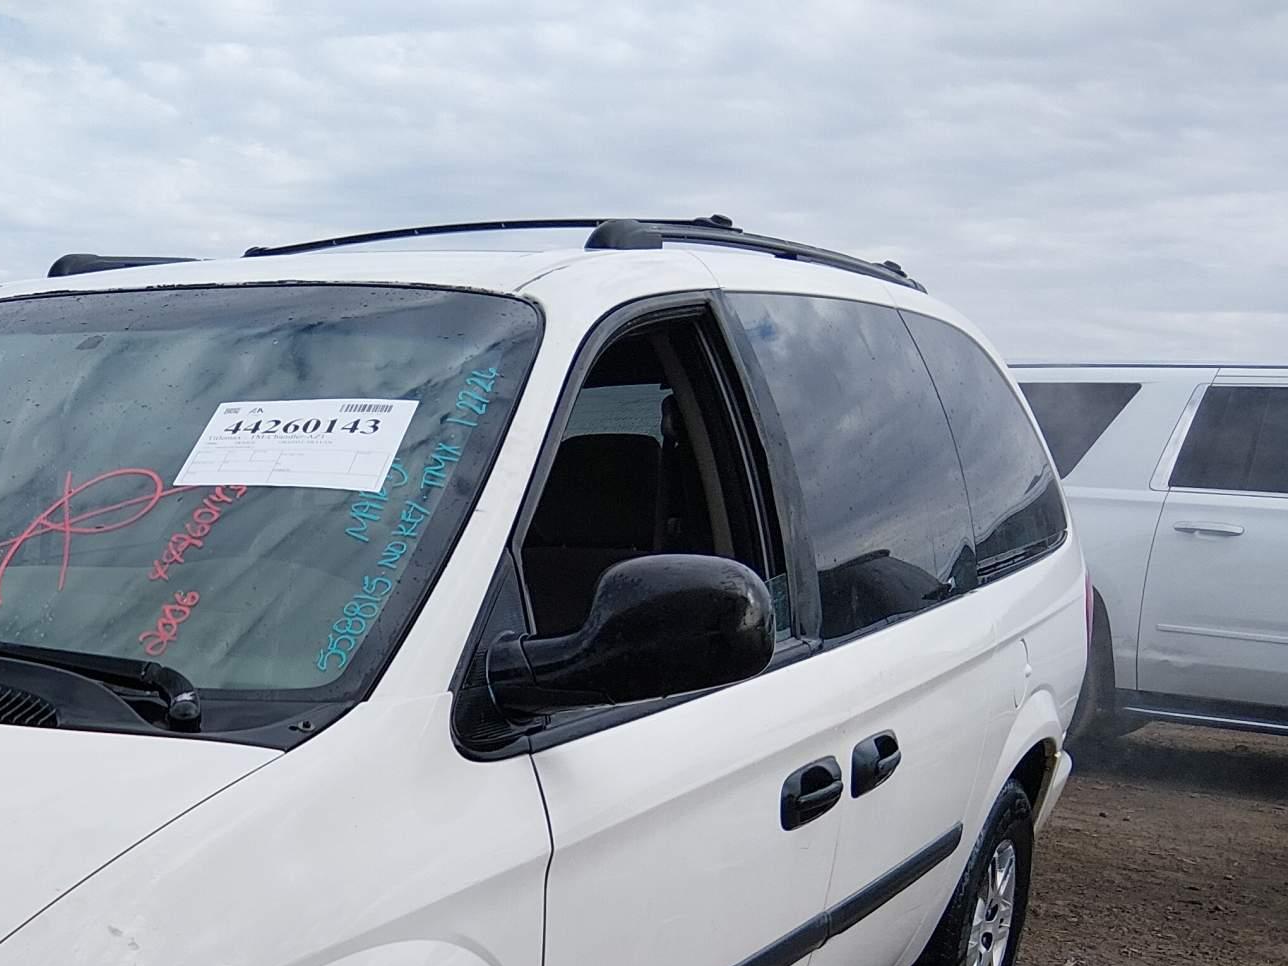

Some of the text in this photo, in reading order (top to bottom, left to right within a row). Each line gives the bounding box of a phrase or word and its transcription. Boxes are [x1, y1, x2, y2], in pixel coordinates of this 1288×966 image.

[224, 418, 381, 435] 44260143
[392, 500, 431, 538] KEY
[378, 542, 407, 569] NO
[139, 591, 200, 656] 2006
[317, 576, 392, 670] 558815
